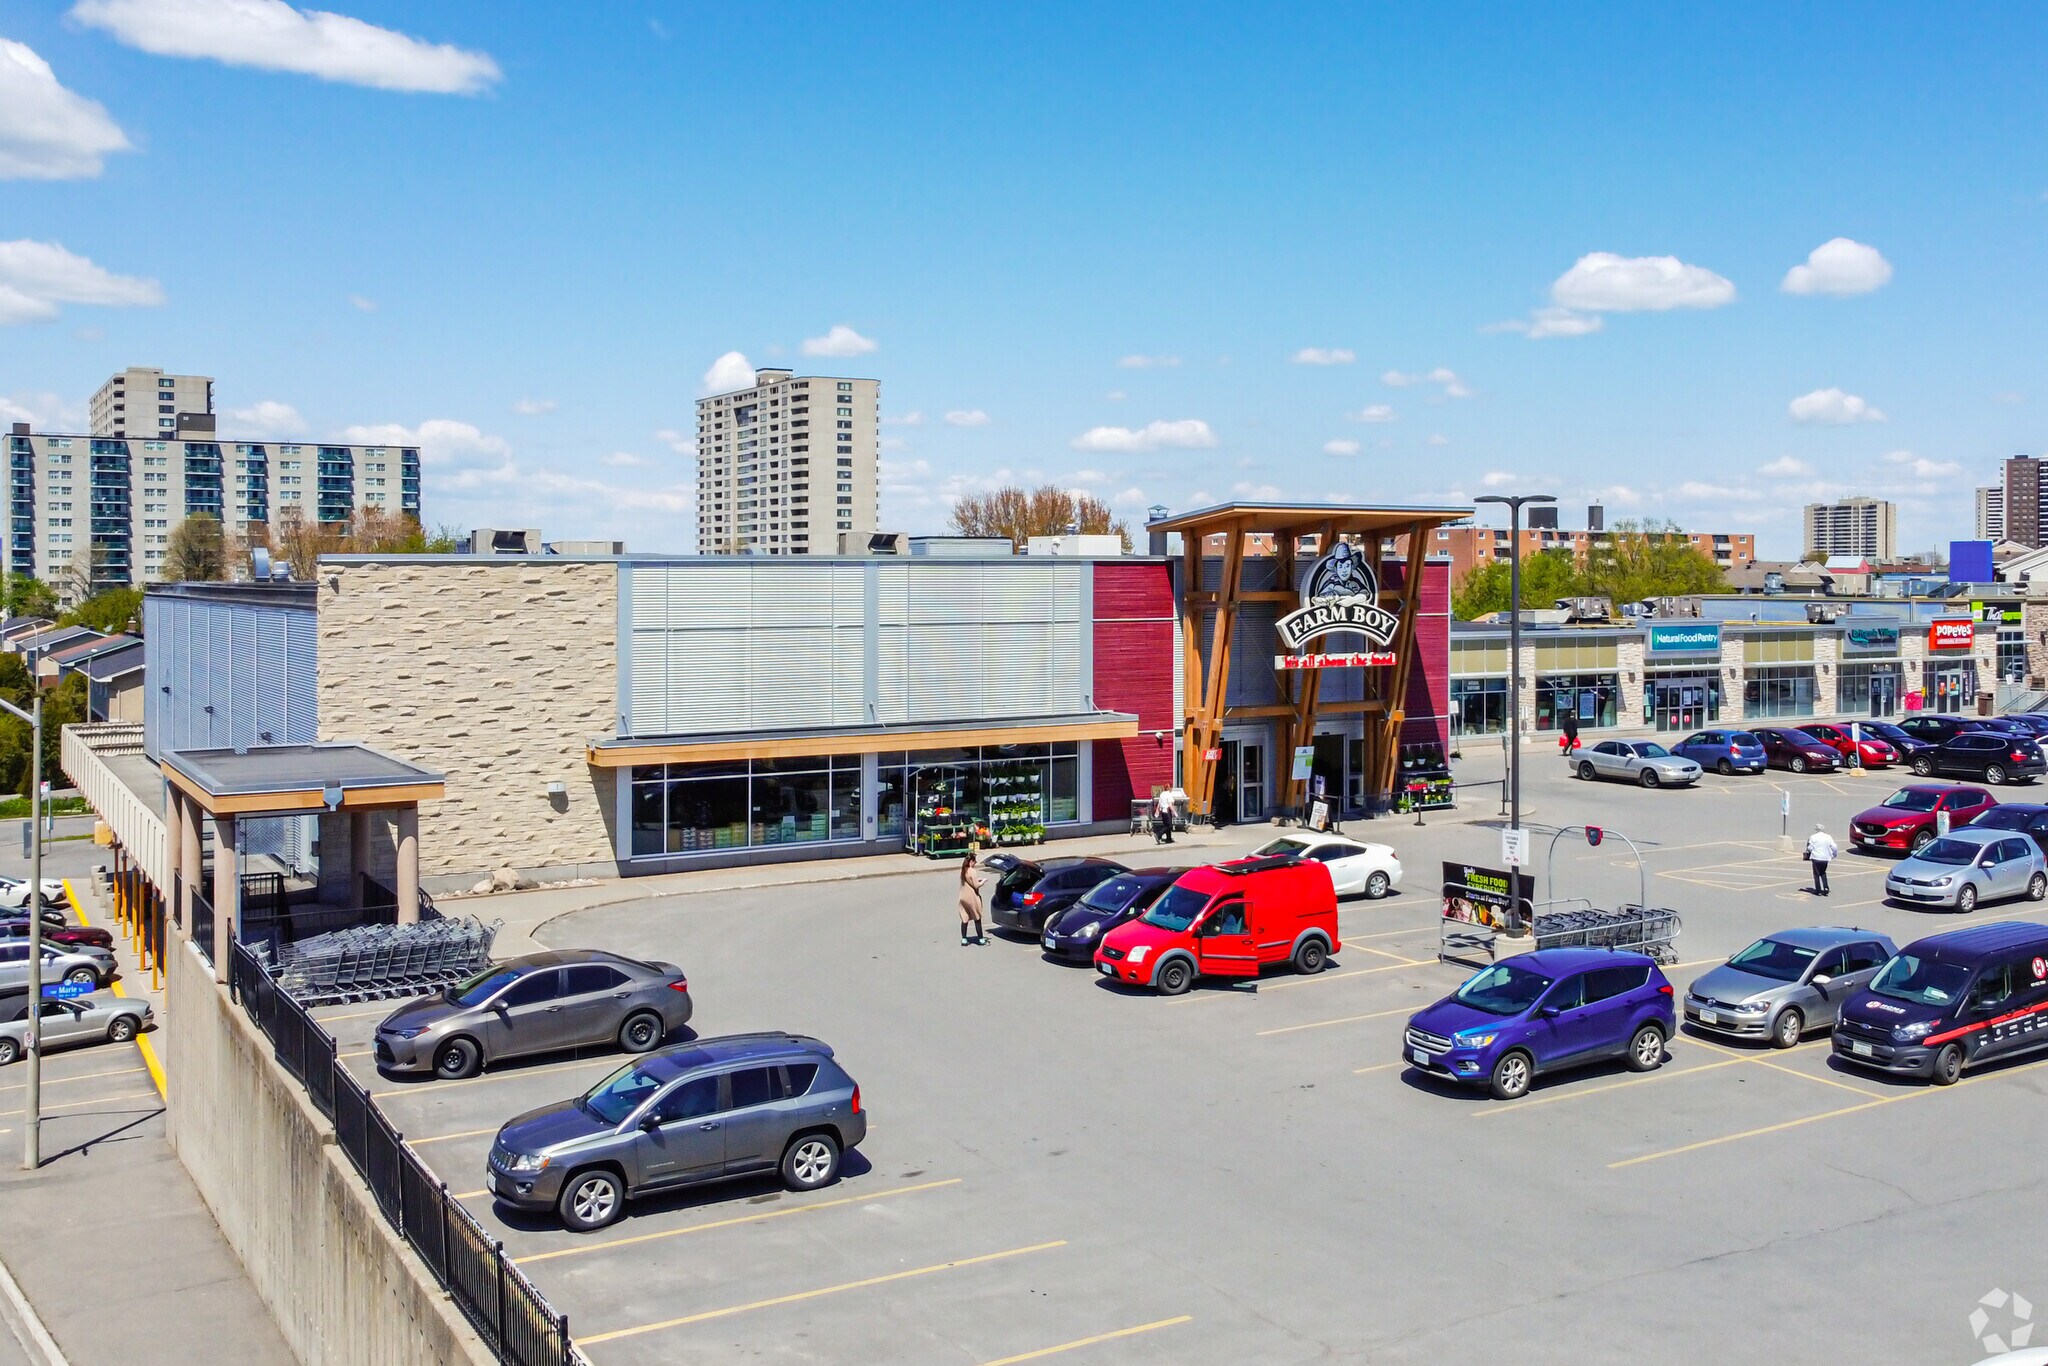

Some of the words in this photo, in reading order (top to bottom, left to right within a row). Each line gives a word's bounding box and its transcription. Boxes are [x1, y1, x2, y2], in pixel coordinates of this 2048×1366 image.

[1290, 606, 1347, 639] FARM
[1352, 605, 1394, 633] BOY
[1656, 634, 1680, 643] Natural
[1680, 633, 1697, 643] Food
[1698, 633, 1718, 644] Pantry
[1467, 873, 1488, 885] FRESH
[1489, 877, 1508, 888] FOOD
[58, 986, 77, 994] Marie
